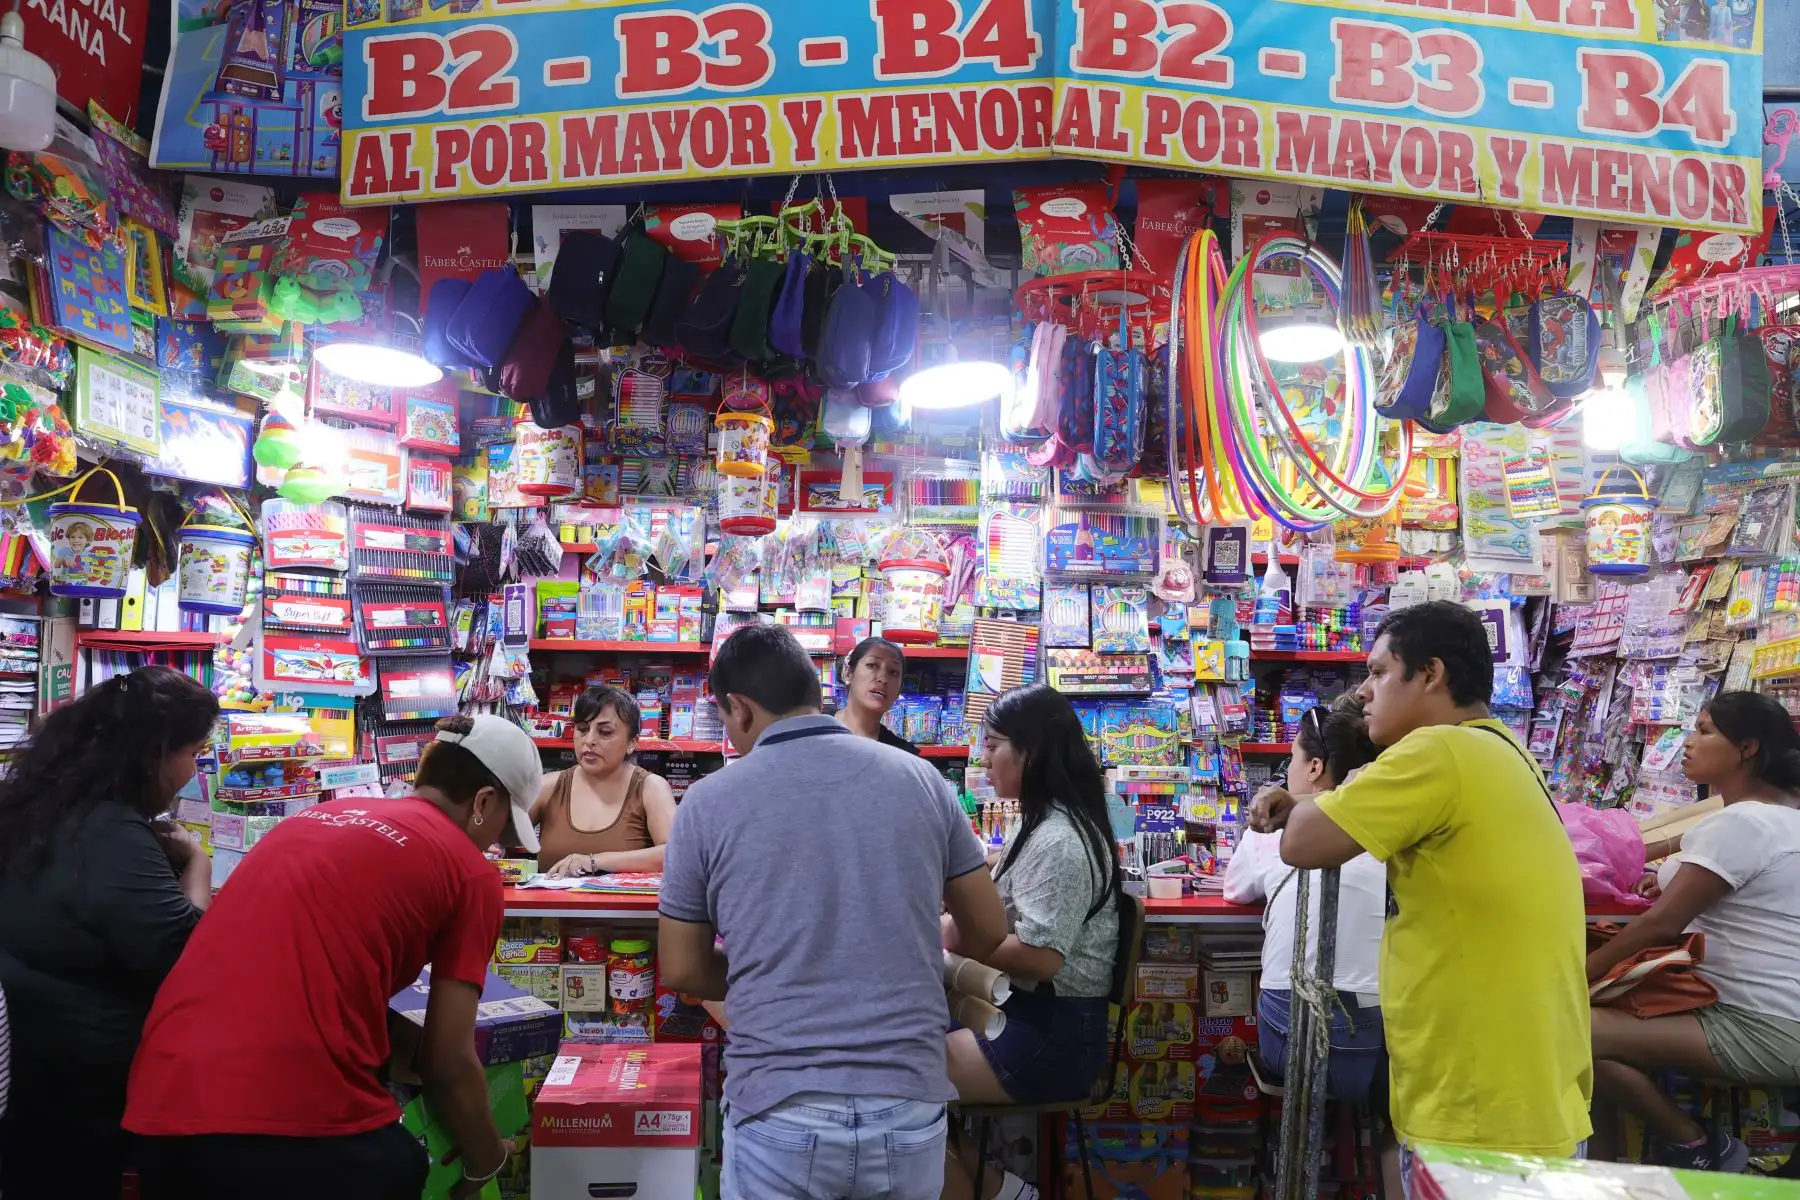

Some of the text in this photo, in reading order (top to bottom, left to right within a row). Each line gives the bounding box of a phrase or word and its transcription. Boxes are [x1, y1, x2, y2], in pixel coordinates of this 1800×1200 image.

[367, 27, 515, 117] B2
[618, 8, 770, 95] B3
[875, 0, 1038, 75] B4
[1075, 0, 1231, 84] B2
[1334, 22, 1479, 113] B3
[1580, 50, 1732, 143] B4
[350, 84, 1054, 198] AL POR MAYOR Y MENOR
[1053, 87, 1750, 227] AL POR MAYOR Y MENOR
[283, 606, 311, 619] Super
[235, 724, 264, 732] Arthur
[263, 748, 286, 756] Arthur
[1146, 809, 1175, 821] P922
[502, 950, 528, 961] Vertical
[1199, 1025, 1233, 1035] LOTTO
[541, 1114, 613, 1128] MILLENIUM
[637, 1112, 661, 1129] A4
